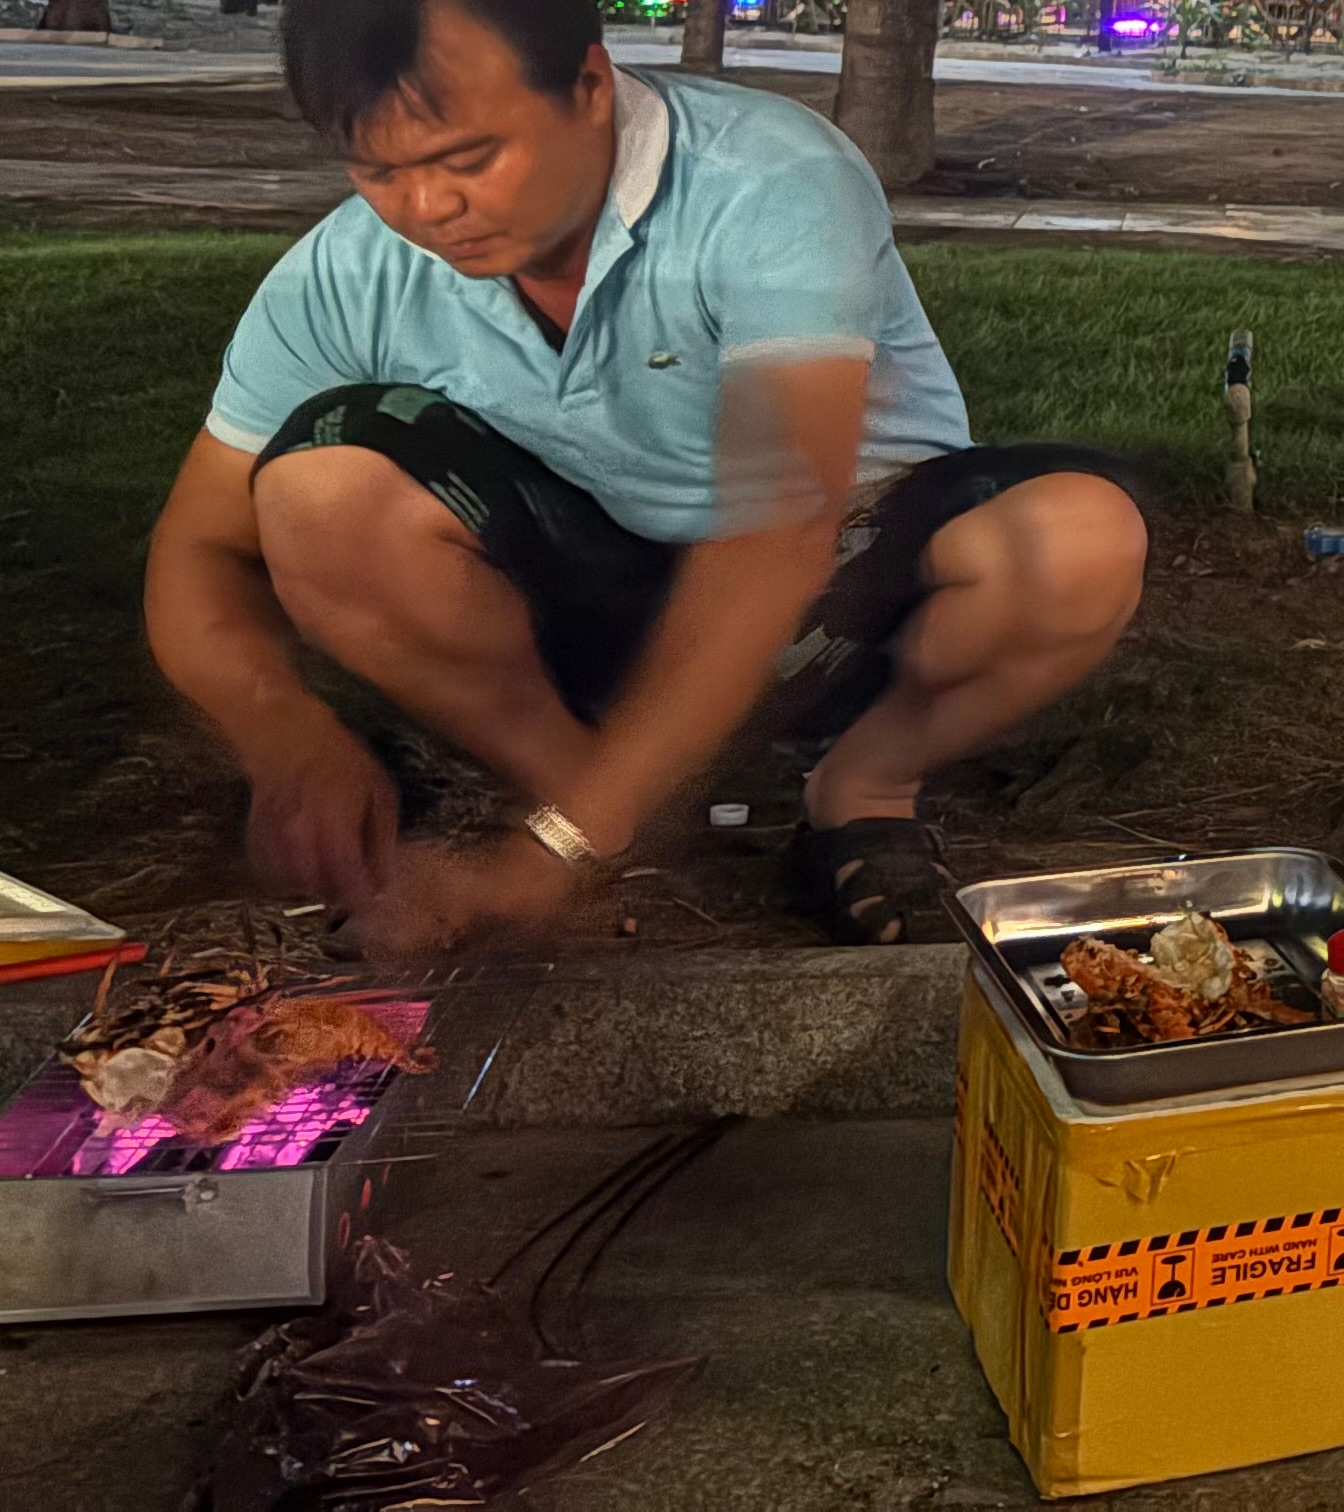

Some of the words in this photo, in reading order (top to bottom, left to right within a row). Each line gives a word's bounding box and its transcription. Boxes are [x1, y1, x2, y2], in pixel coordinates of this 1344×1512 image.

[1248, 1244, 1280, 1257] WITH
[1282, 1238, 1317, 1252] HAND
[1211, 1249, 1247, 1263] CARE
[1114, 1267, 1139, 1279] VUI
[1210, 1251, 1317, 1286] FRAGILE
[1077, 1280, 1139, 1308] HÀNG
